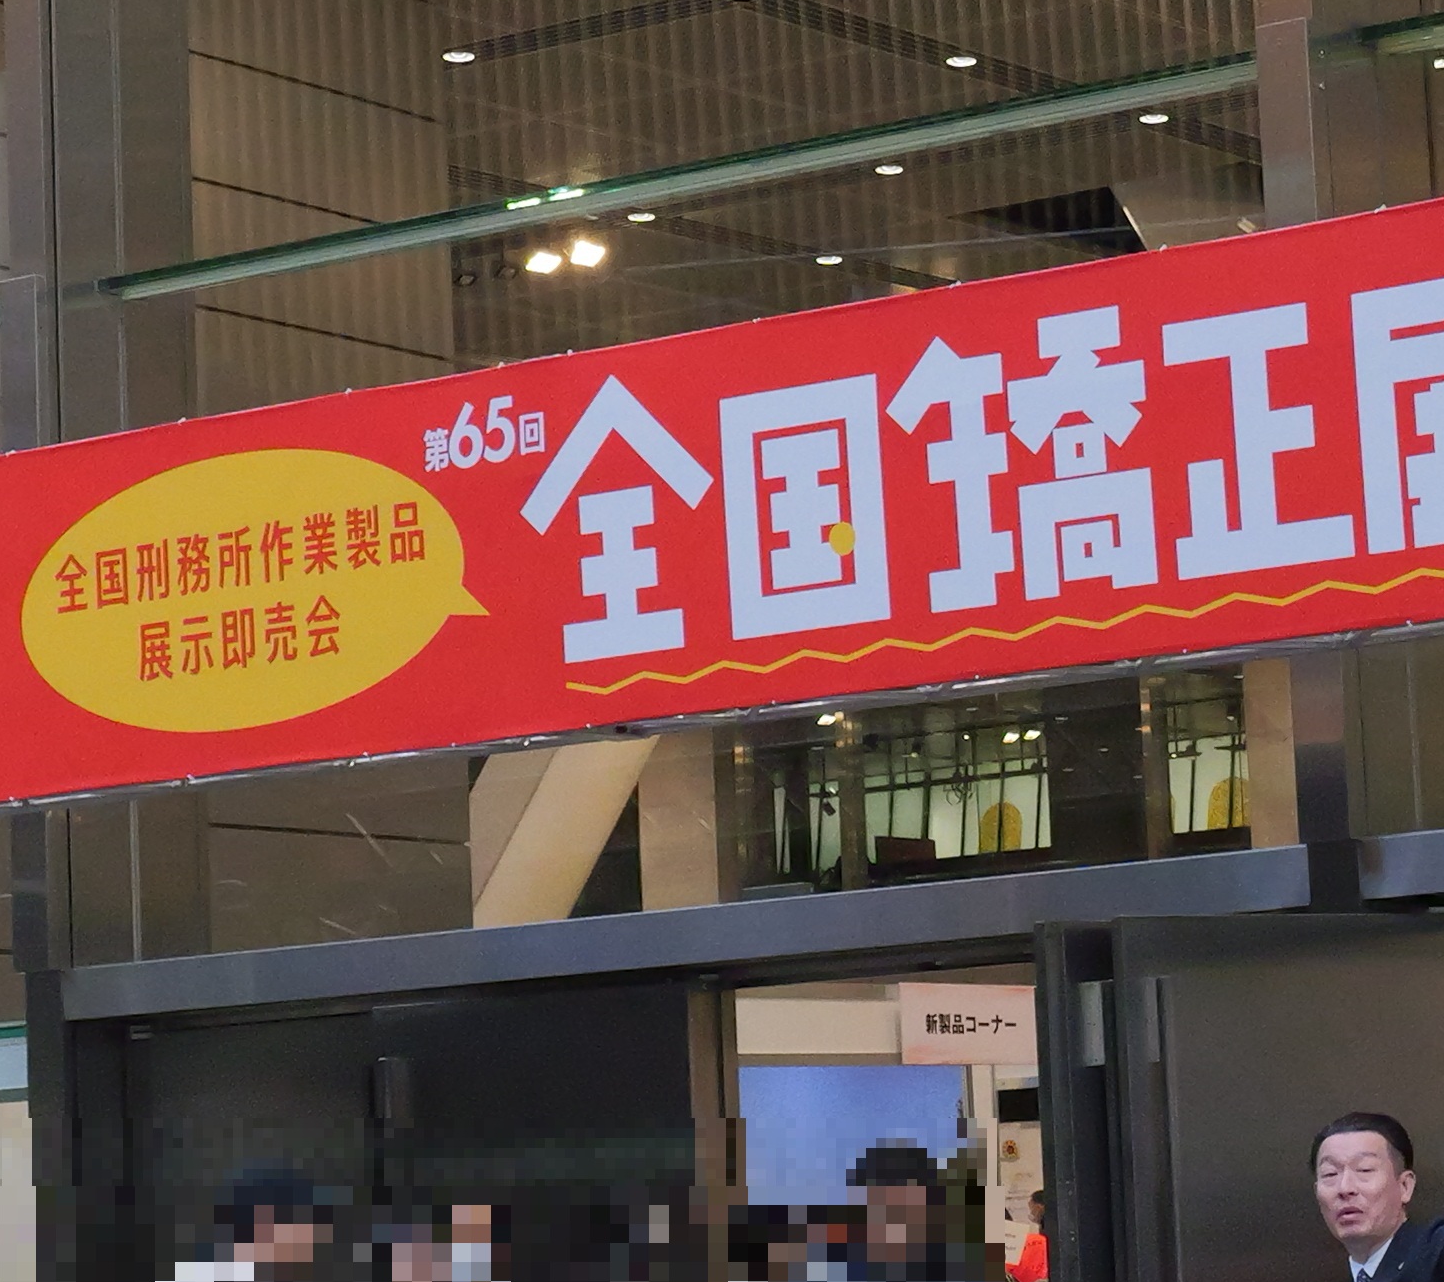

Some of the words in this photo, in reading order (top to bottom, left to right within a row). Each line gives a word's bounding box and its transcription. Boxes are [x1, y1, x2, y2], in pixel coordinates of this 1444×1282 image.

[423, 396, 545, 472] 第65回
[55, 500, 426, 614] 全国刑務所作業製品
[139, 596, 341, 682] 展示即売会
[925, 1013, 1017, 1035] 新製品コーナー
